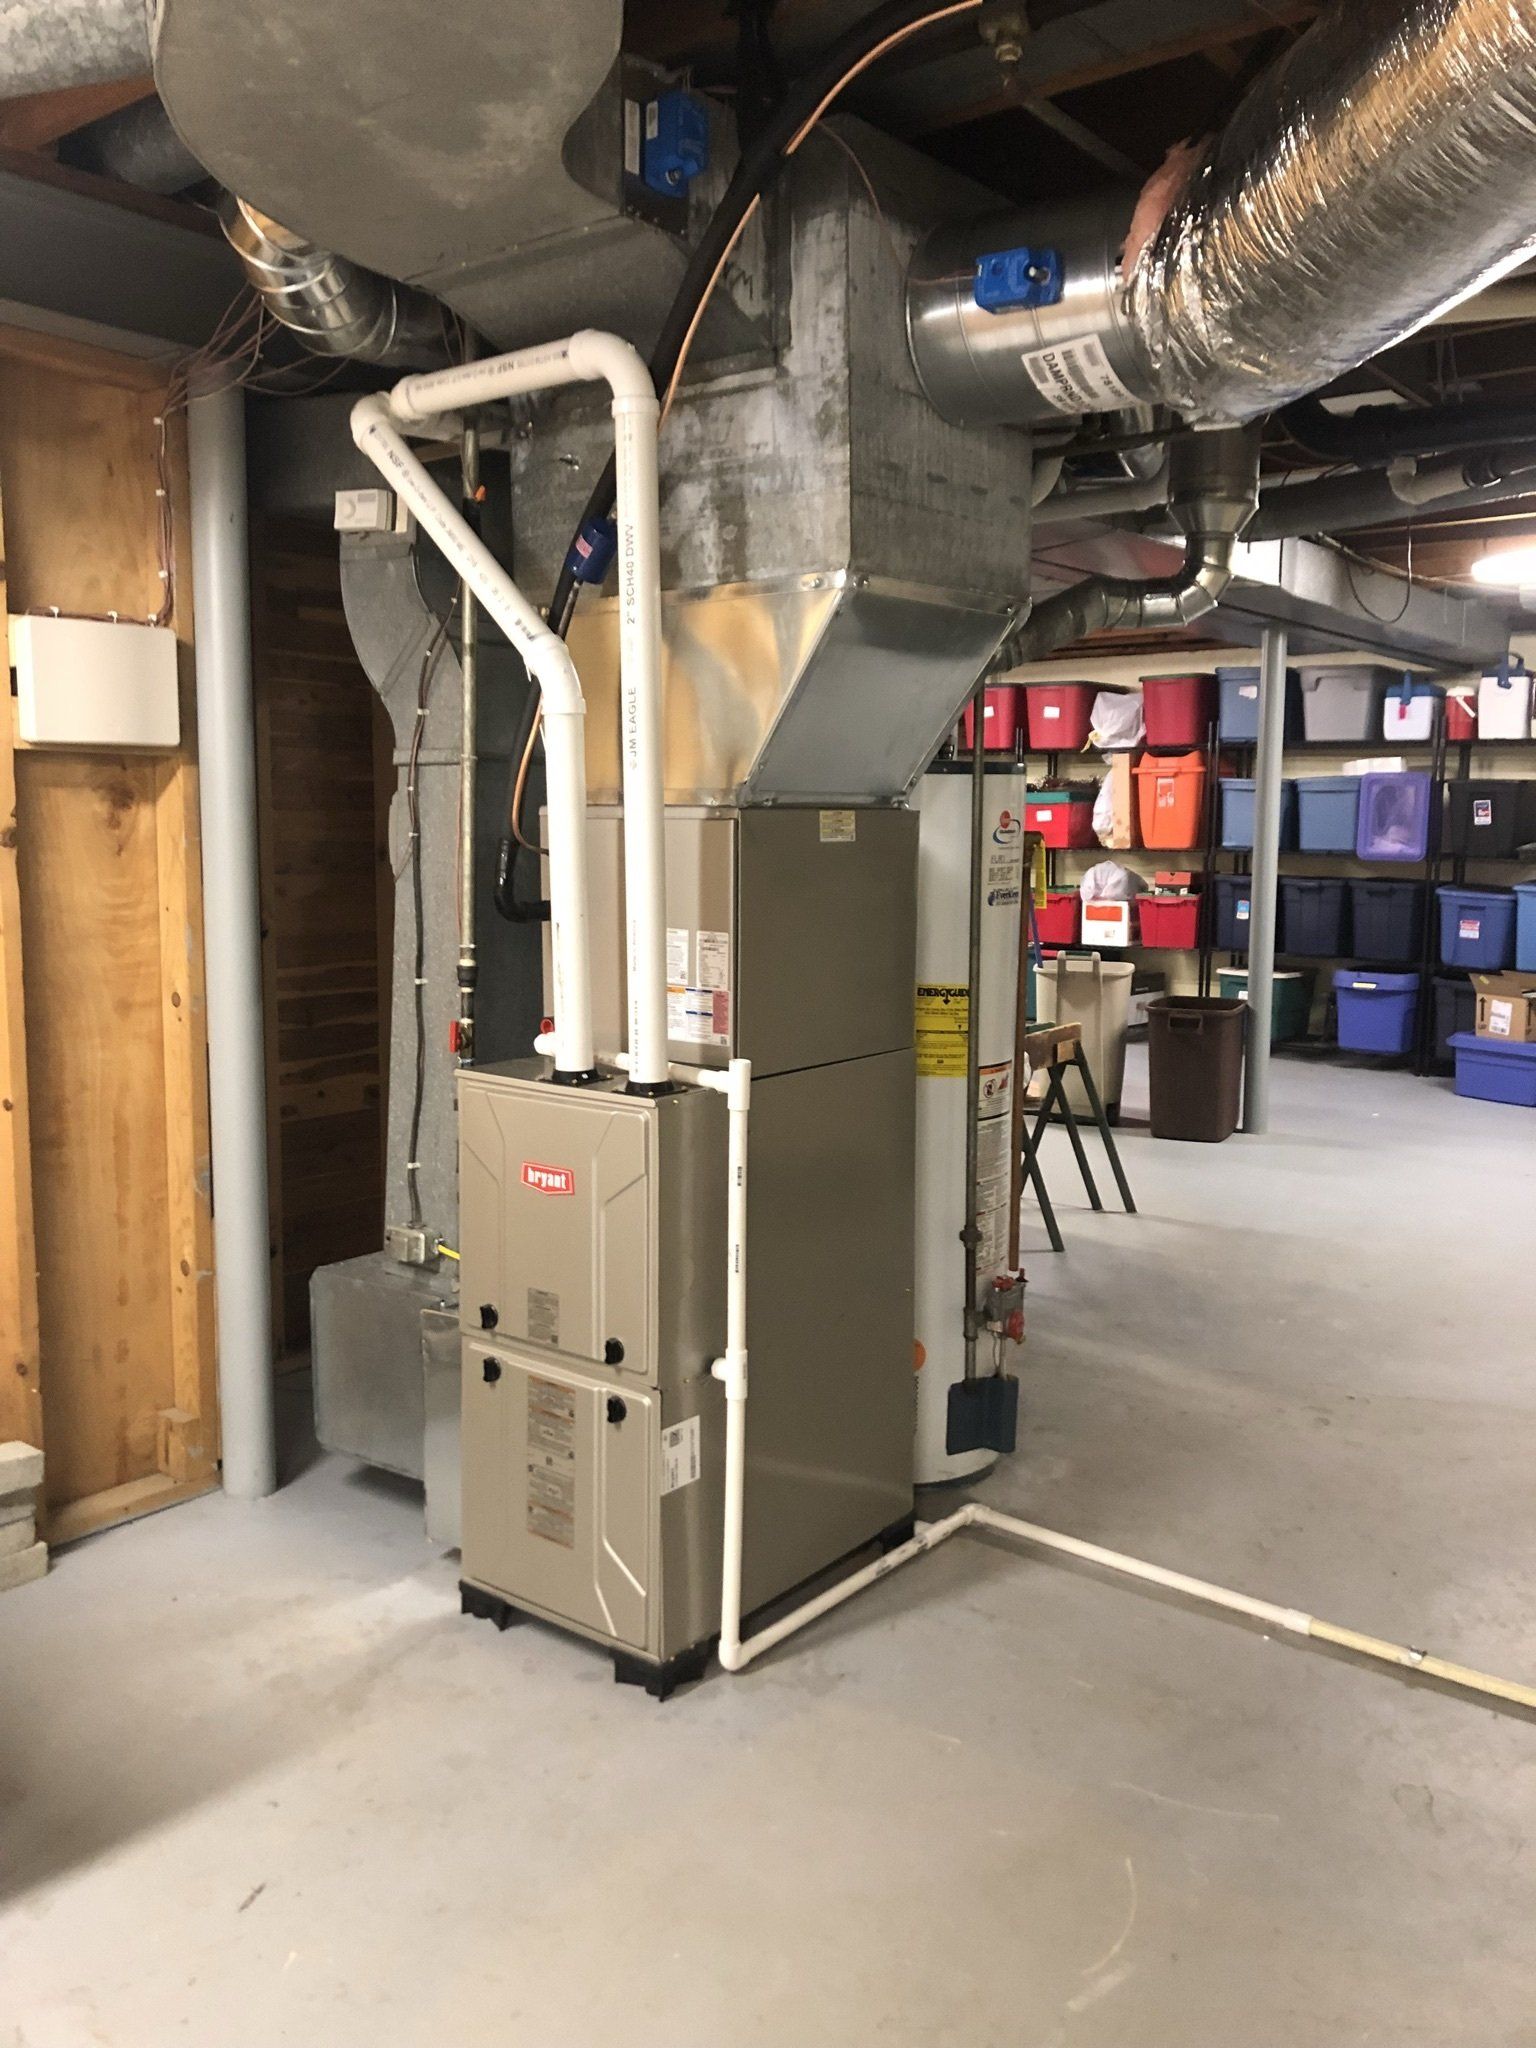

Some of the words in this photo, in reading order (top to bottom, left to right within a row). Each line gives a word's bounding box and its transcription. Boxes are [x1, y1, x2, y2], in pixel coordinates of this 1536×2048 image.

[625, 524, 635, 557] DWV
[626, 561, 636, 607] SCH40
[628, 687, 638, 734] EAGLE
[629, 738, 638, 758] JM
[527, 1166, 567, 1190] bryant
